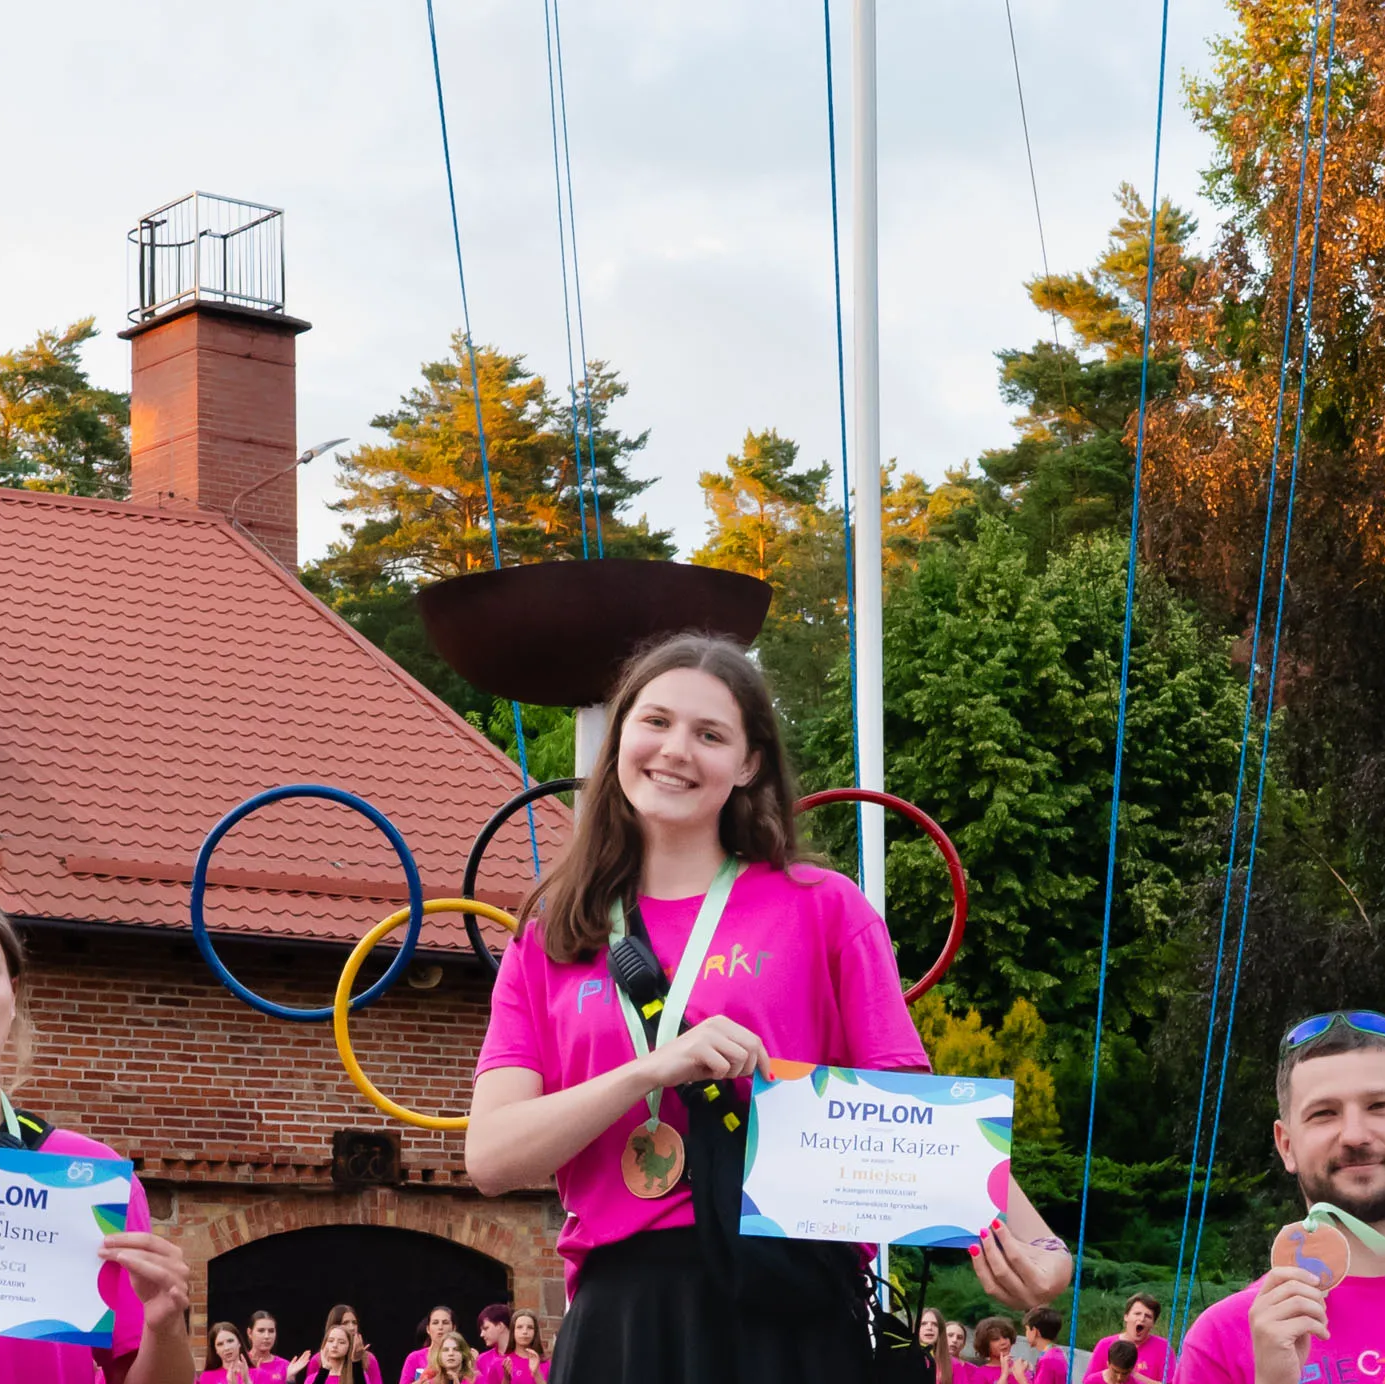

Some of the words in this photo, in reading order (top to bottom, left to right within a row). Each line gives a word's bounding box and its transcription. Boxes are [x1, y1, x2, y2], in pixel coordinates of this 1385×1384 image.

[827, 1100, 933, 1125] DYPLOM
[799, 1131, 884, 1154] Matylda
[892, 1137, 960, 1158] Kajzer
[839, 1166, 846, 1179] 1
[852, 1168, 917, 1184] miejsca
